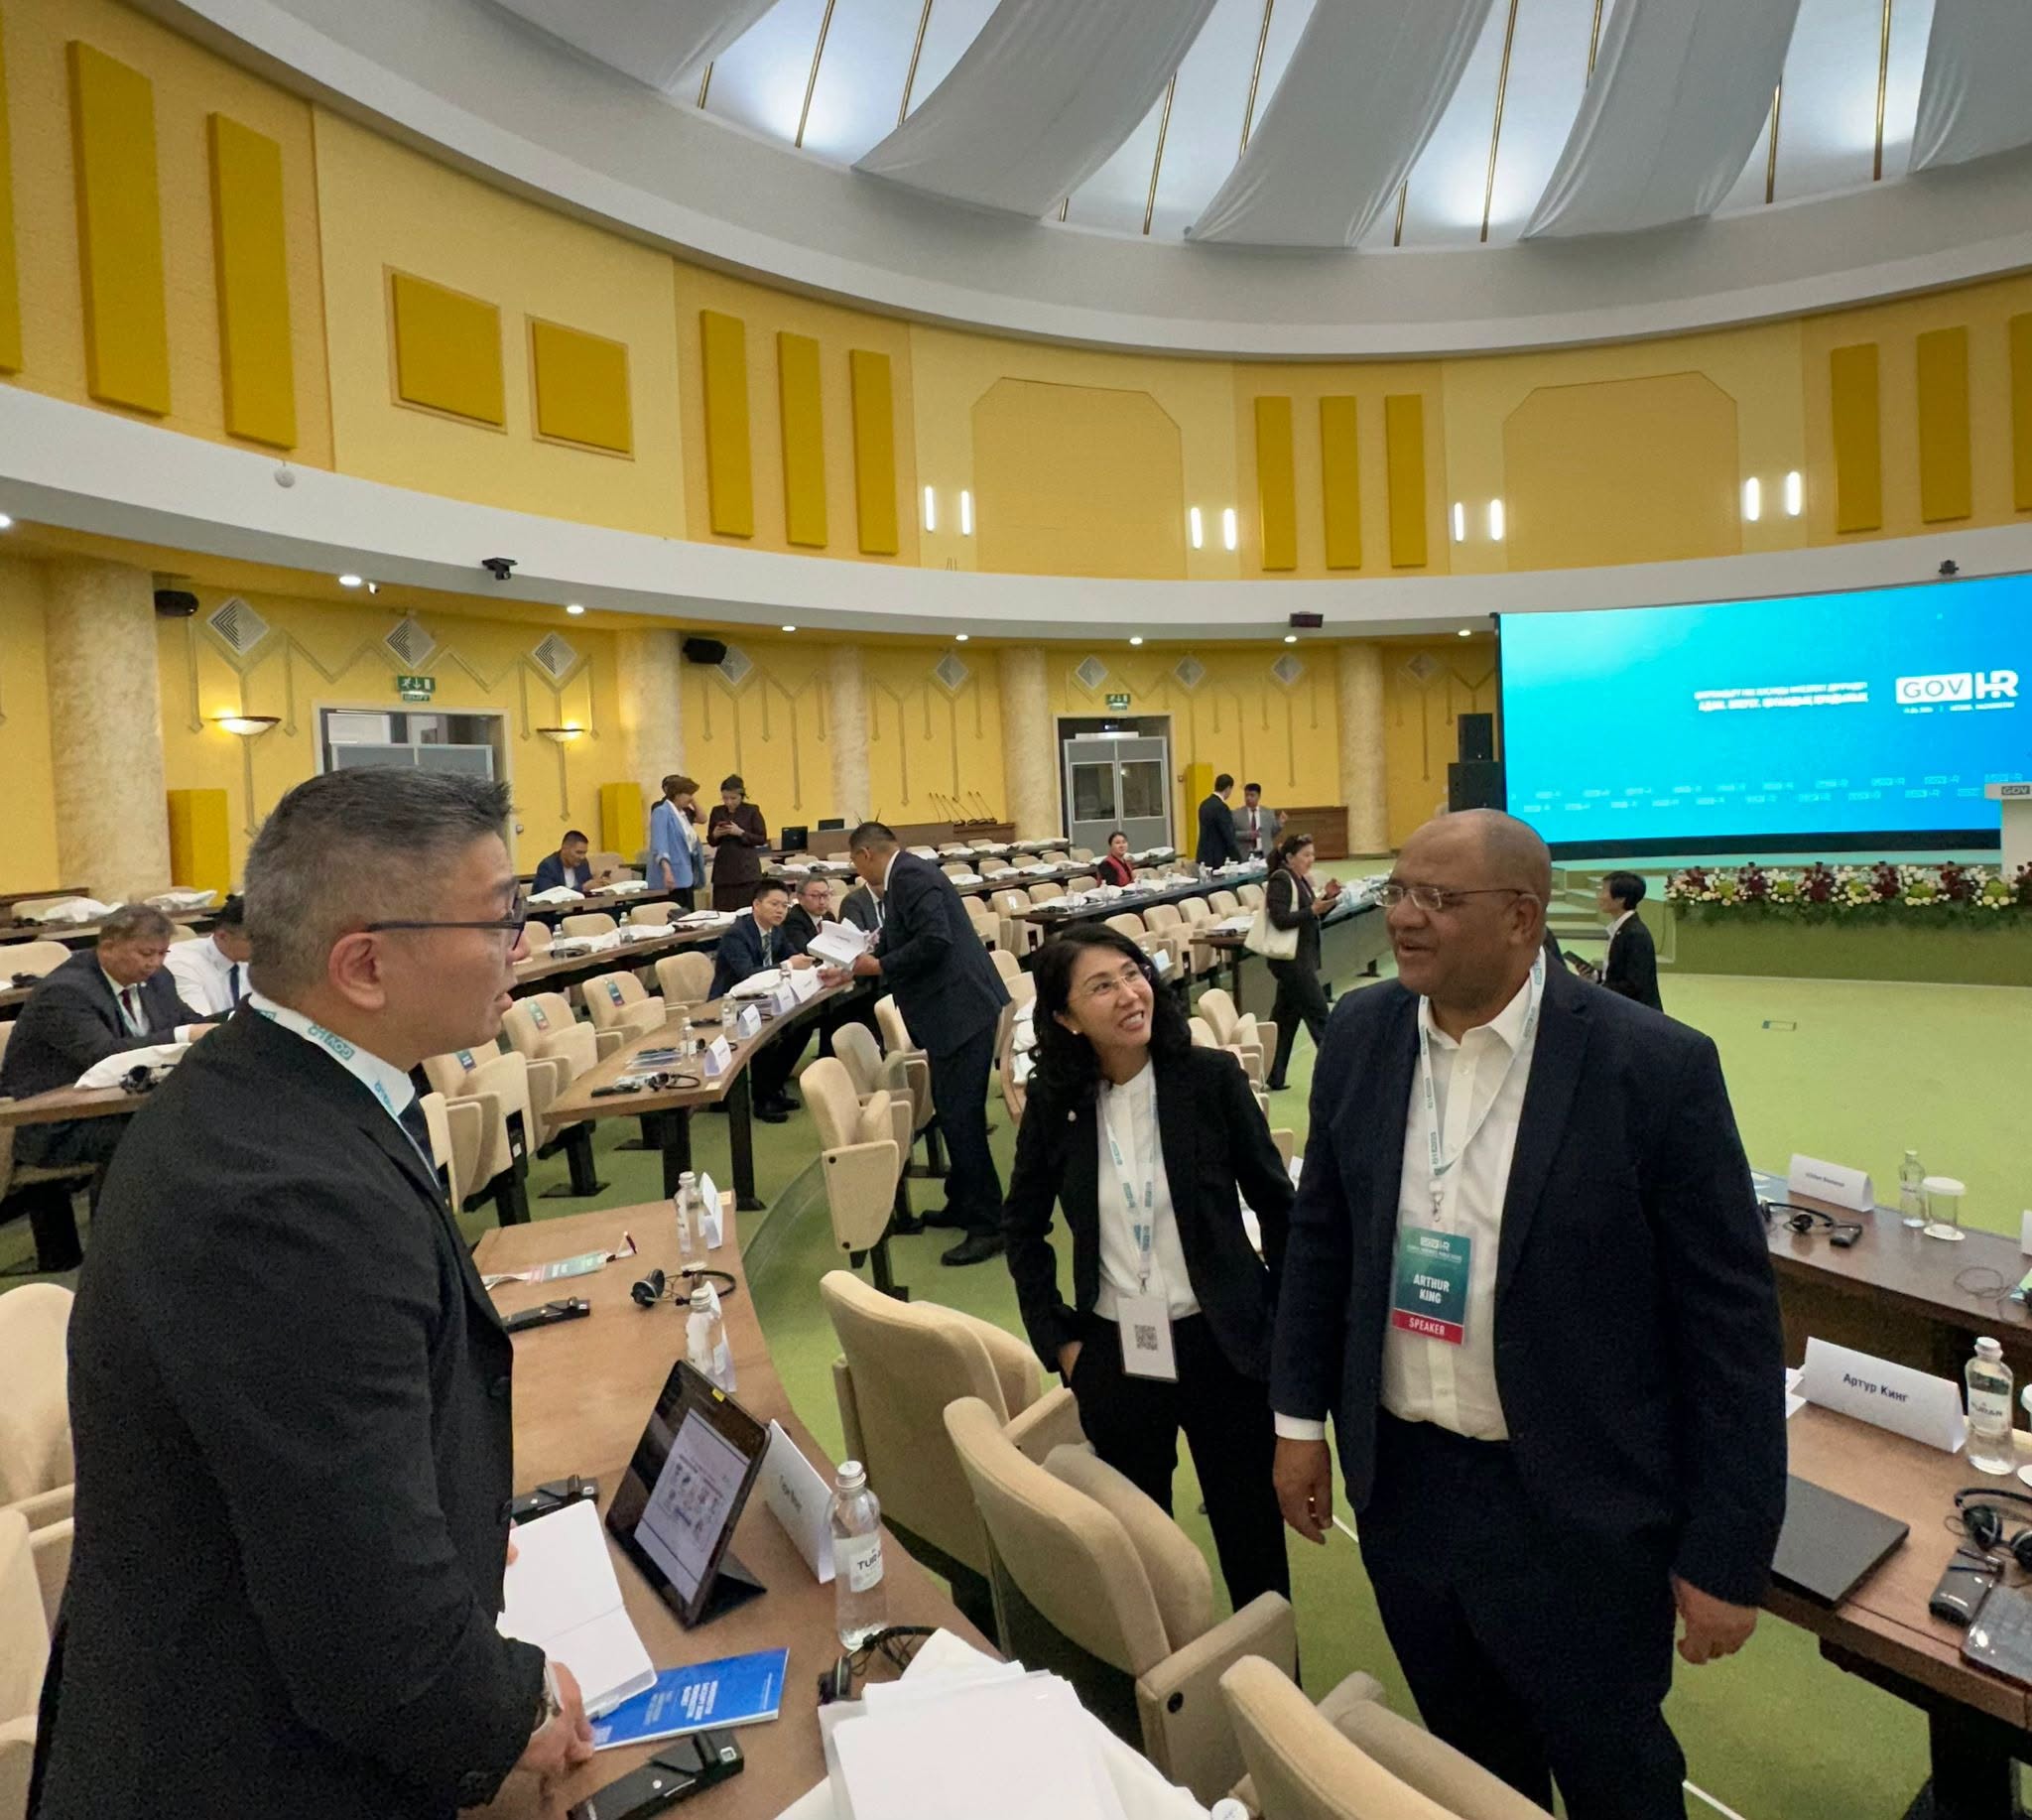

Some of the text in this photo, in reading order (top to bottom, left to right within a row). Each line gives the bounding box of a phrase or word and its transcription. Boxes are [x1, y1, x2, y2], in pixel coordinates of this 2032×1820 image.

[1413, 1274, 1450, 1292] ARTHUR
[1419, 1289, 1442, 1304] KING
[1408, 1318, 1446, 1336] SPEAKER
[1843, 1373, 1908, 1401] Артур Кинг
